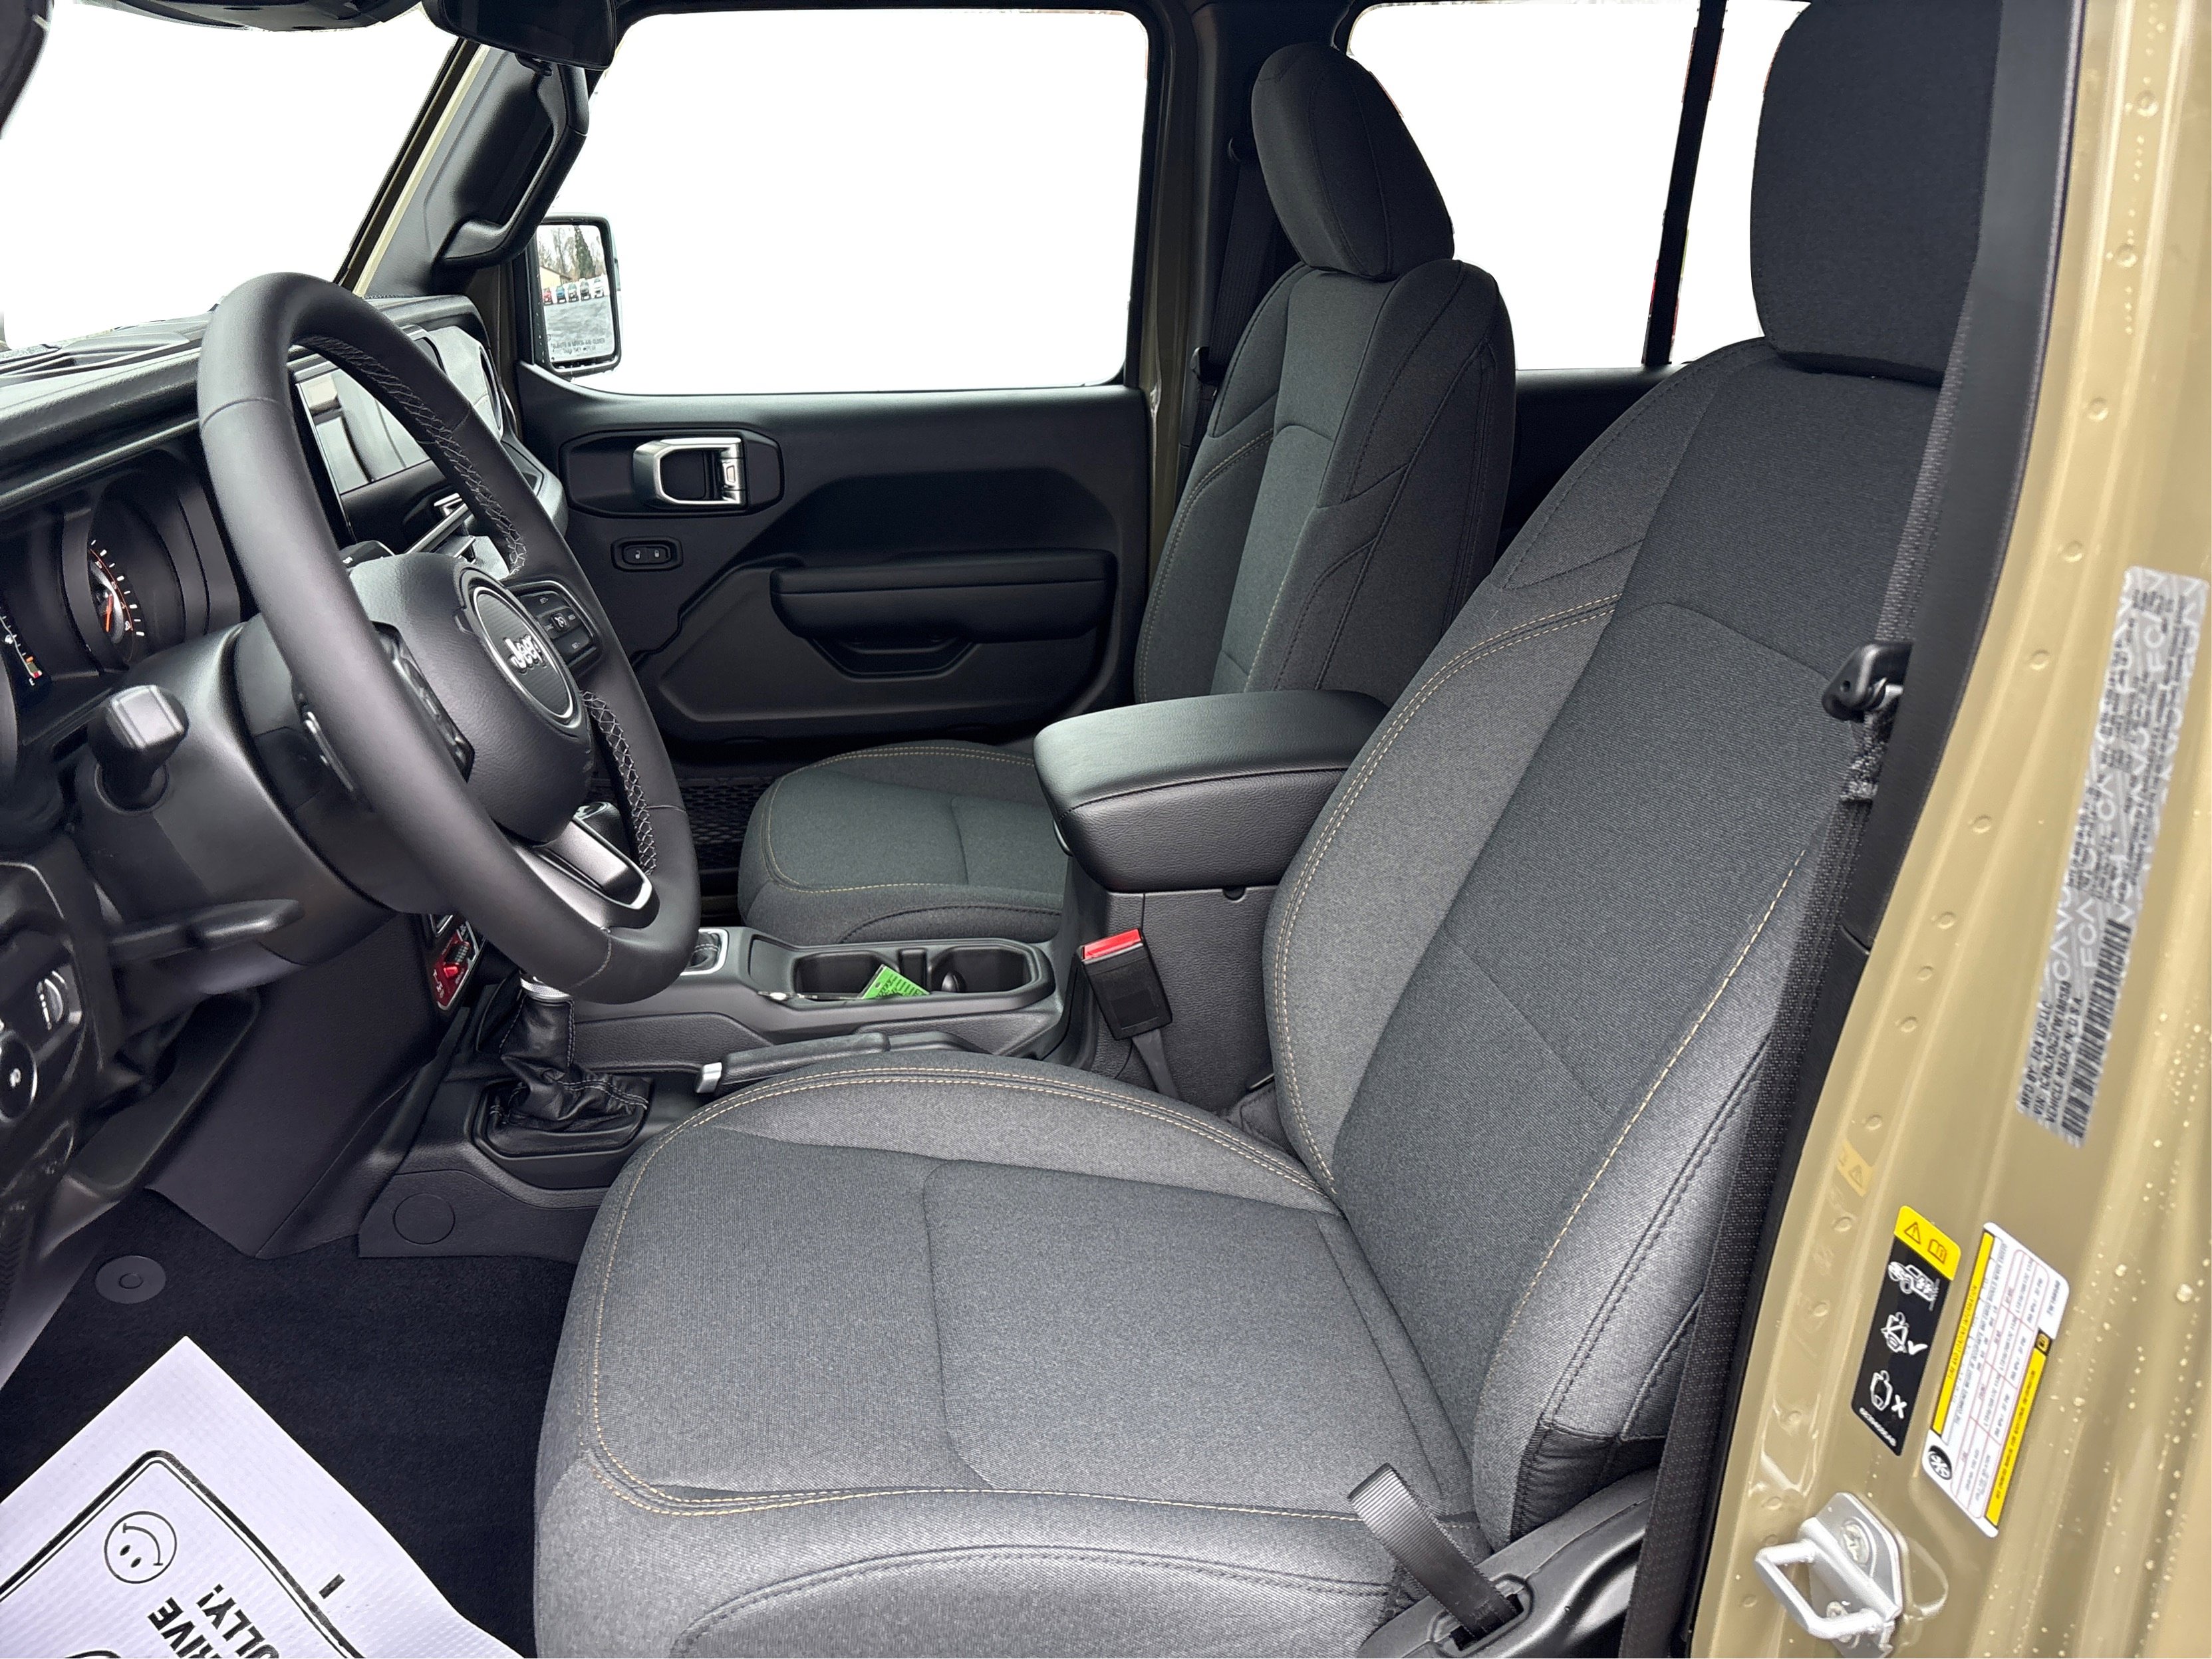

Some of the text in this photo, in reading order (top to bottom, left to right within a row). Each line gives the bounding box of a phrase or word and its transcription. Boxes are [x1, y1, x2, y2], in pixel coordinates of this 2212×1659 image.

[504, 634, 543, 669] Jeep
[2035, 1021, 2048, 1038] US
[2046, 1081, 2063, 1123] VEHICLE
[2056, 1047, 2070, 1079] MADE
